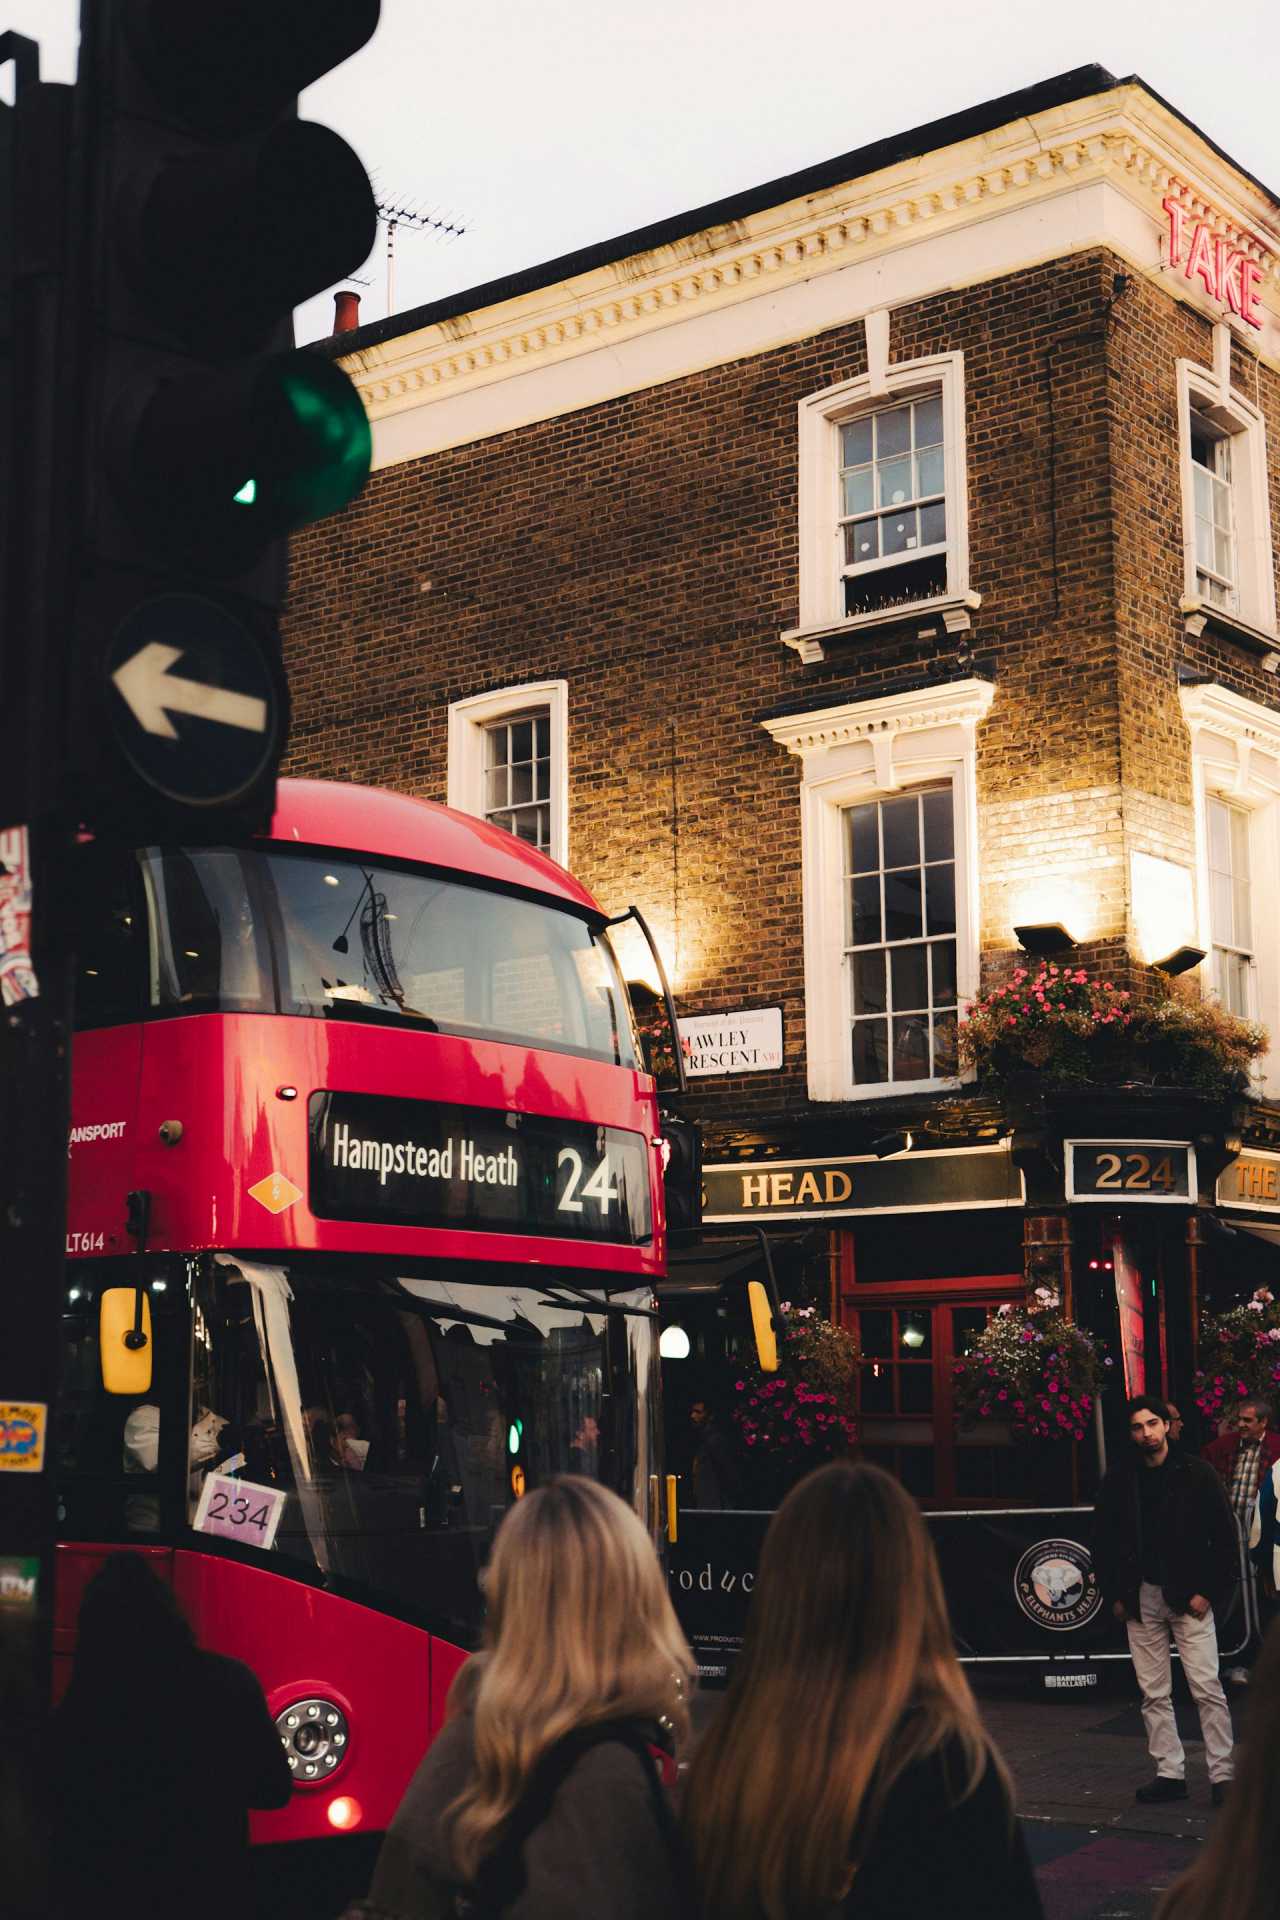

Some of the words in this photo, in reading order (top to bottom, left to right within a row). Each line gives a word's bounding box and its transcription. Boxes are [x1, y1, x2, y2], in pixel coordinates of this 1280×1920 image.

[1163, 197, 1264, 330] TAKE
[689, 1048, 760, 1070] RESCENT
[69, 1121, 127, 1143] ANSPORT
[333, 1122, 453, 1186] Hampstead
[460, 1138, 519, 1187] Heath
[557, 1146, 619, 1215] 24
[1095, 1153, 1175, 1191] 224
[1237, 1161, 1279, 1199] THE
[741, 1170, 852, 1208] HEAD
[65, 1232, 105, 1253] LT614
[207, 1492, 270, 1532] 234
[670, 1562, 754, 1593] oduc
[1027, 1595, 1076, 1621] ELEPHANTS
[1077, 1587, 1097, 1614] HEAD
